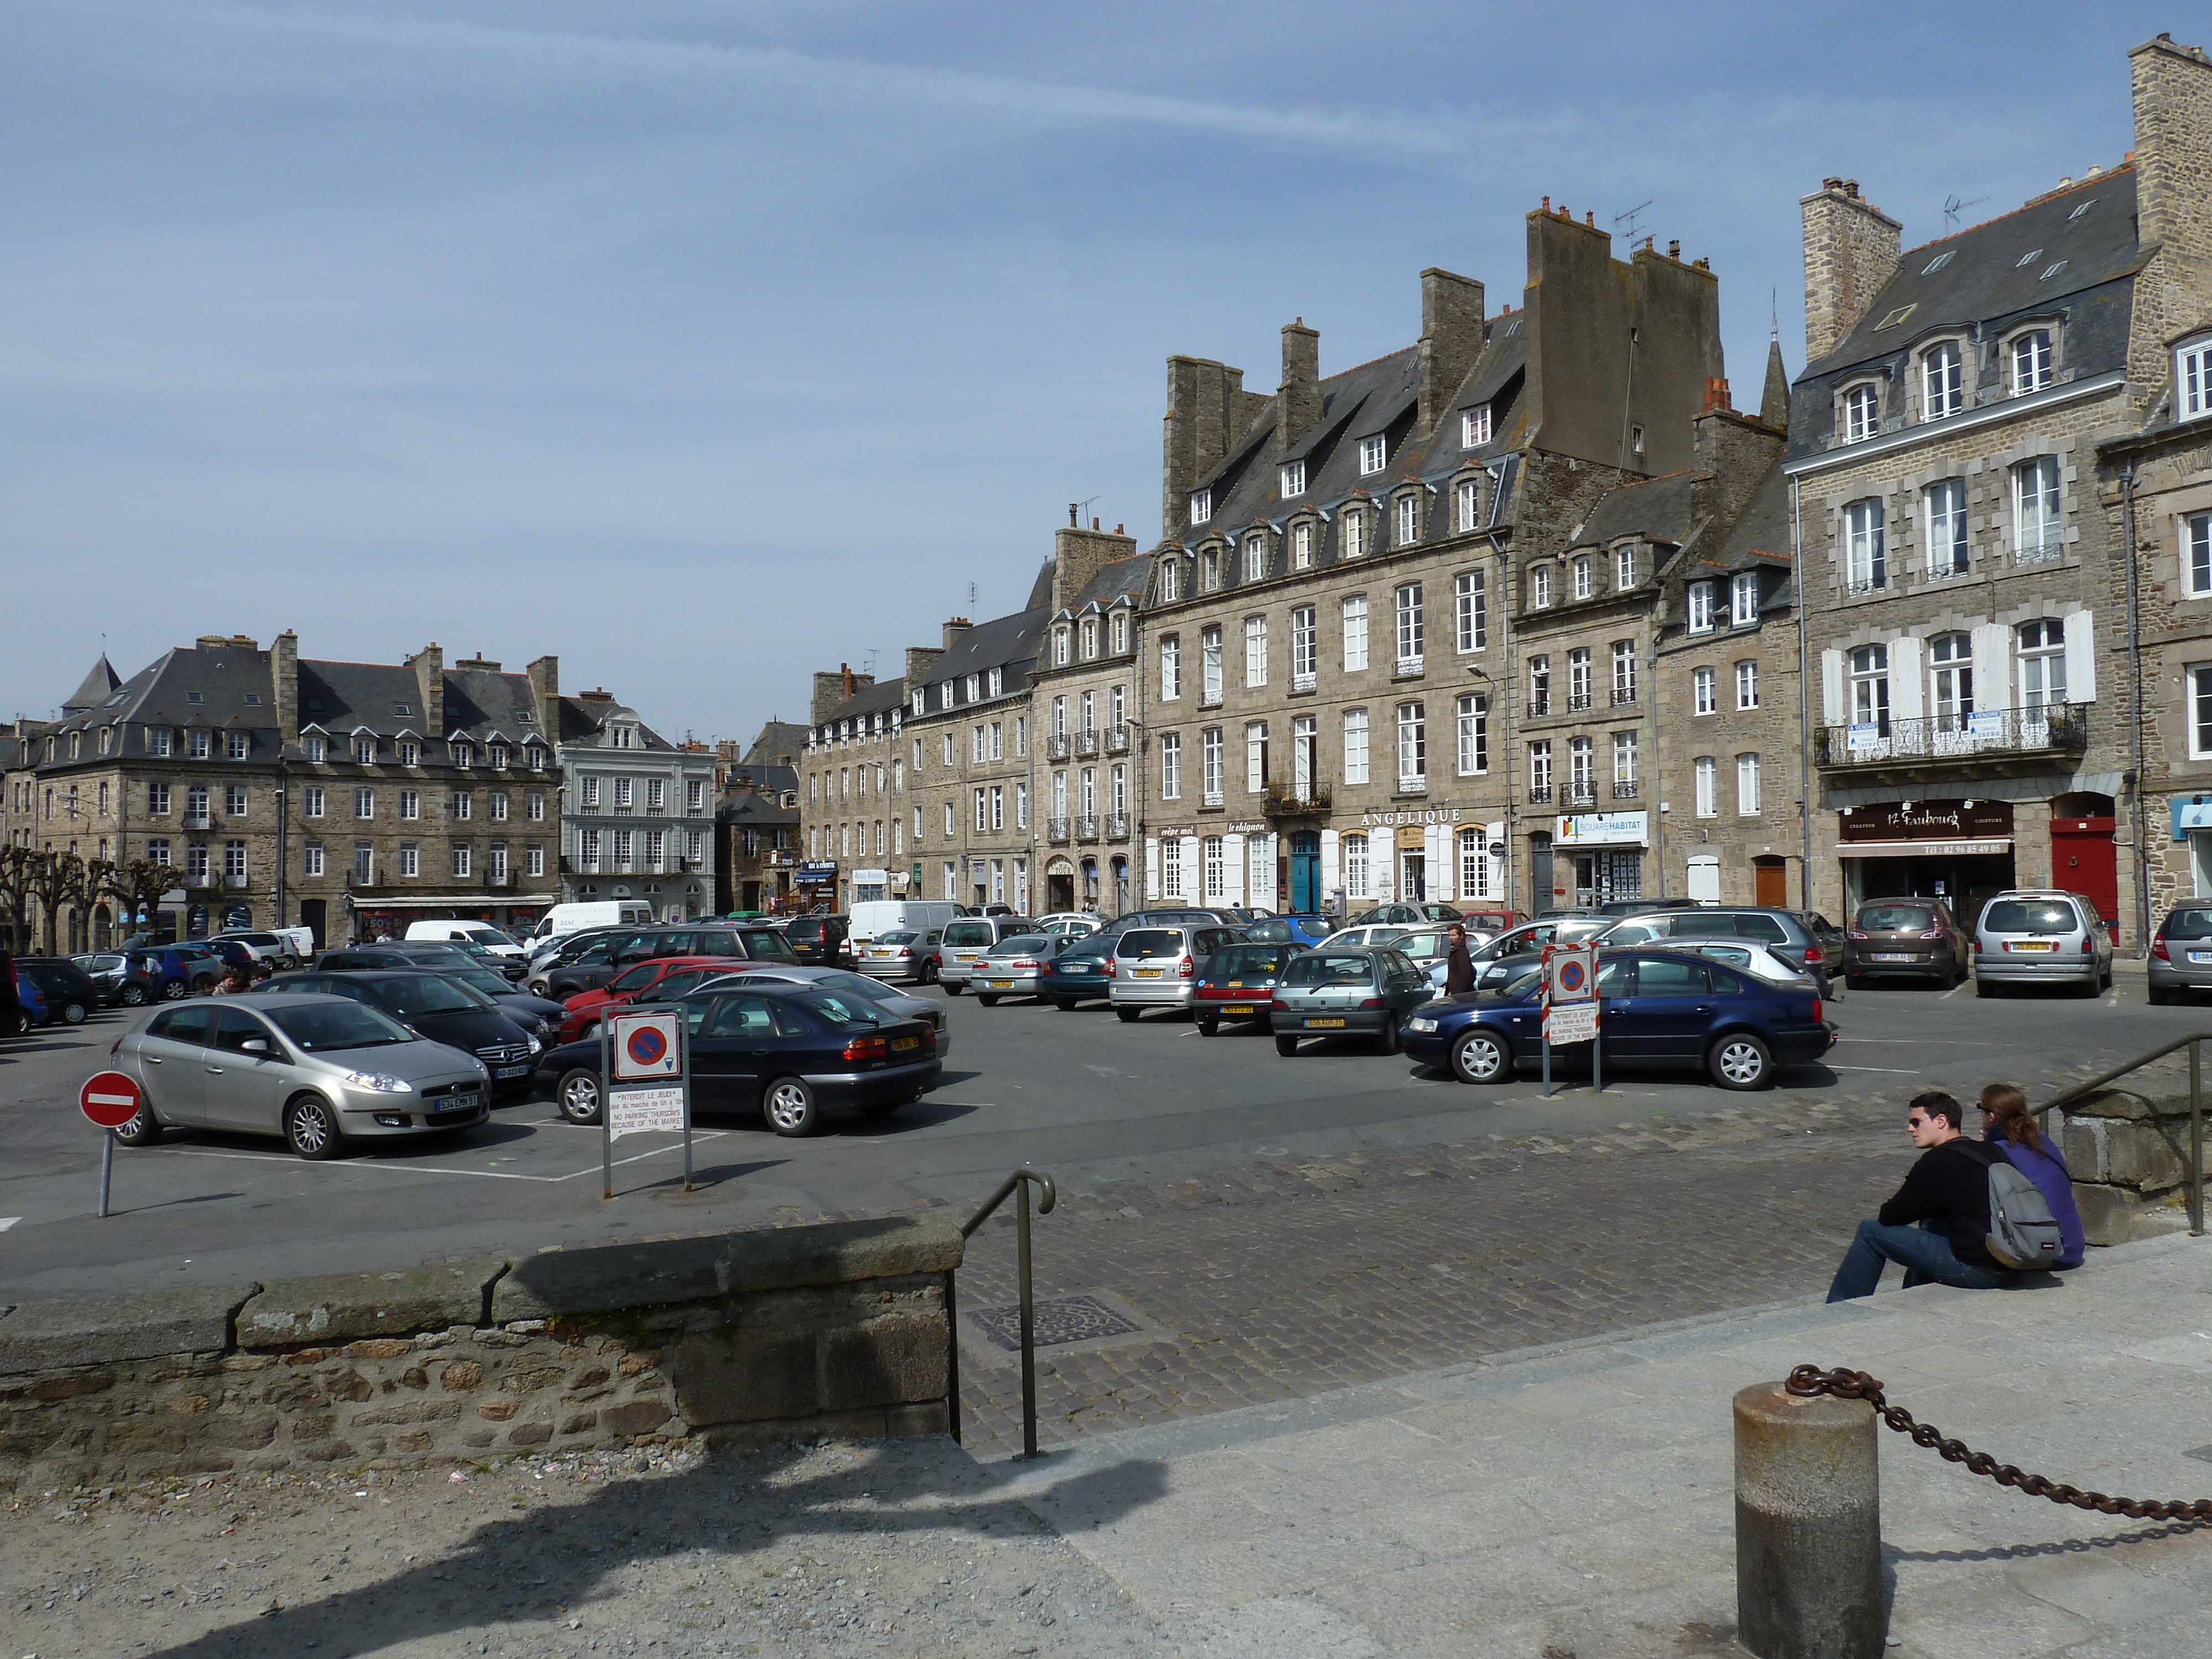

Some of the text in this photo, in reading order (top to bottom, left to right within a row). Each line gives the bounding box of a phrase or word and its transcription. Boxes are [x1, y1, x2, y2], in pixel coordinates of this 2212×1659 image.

[1361, 808, 1460, 826] ANGELIQUE
[1901, 809, 1960, 832] Faubourg
[1161, 826, 1193, 836] crêpe moi
[1229, 821, 1265, 832] le chignon
[441, 1099, 453, 1109] 534
[611, 1120, 635, 1129] BECAUSE
